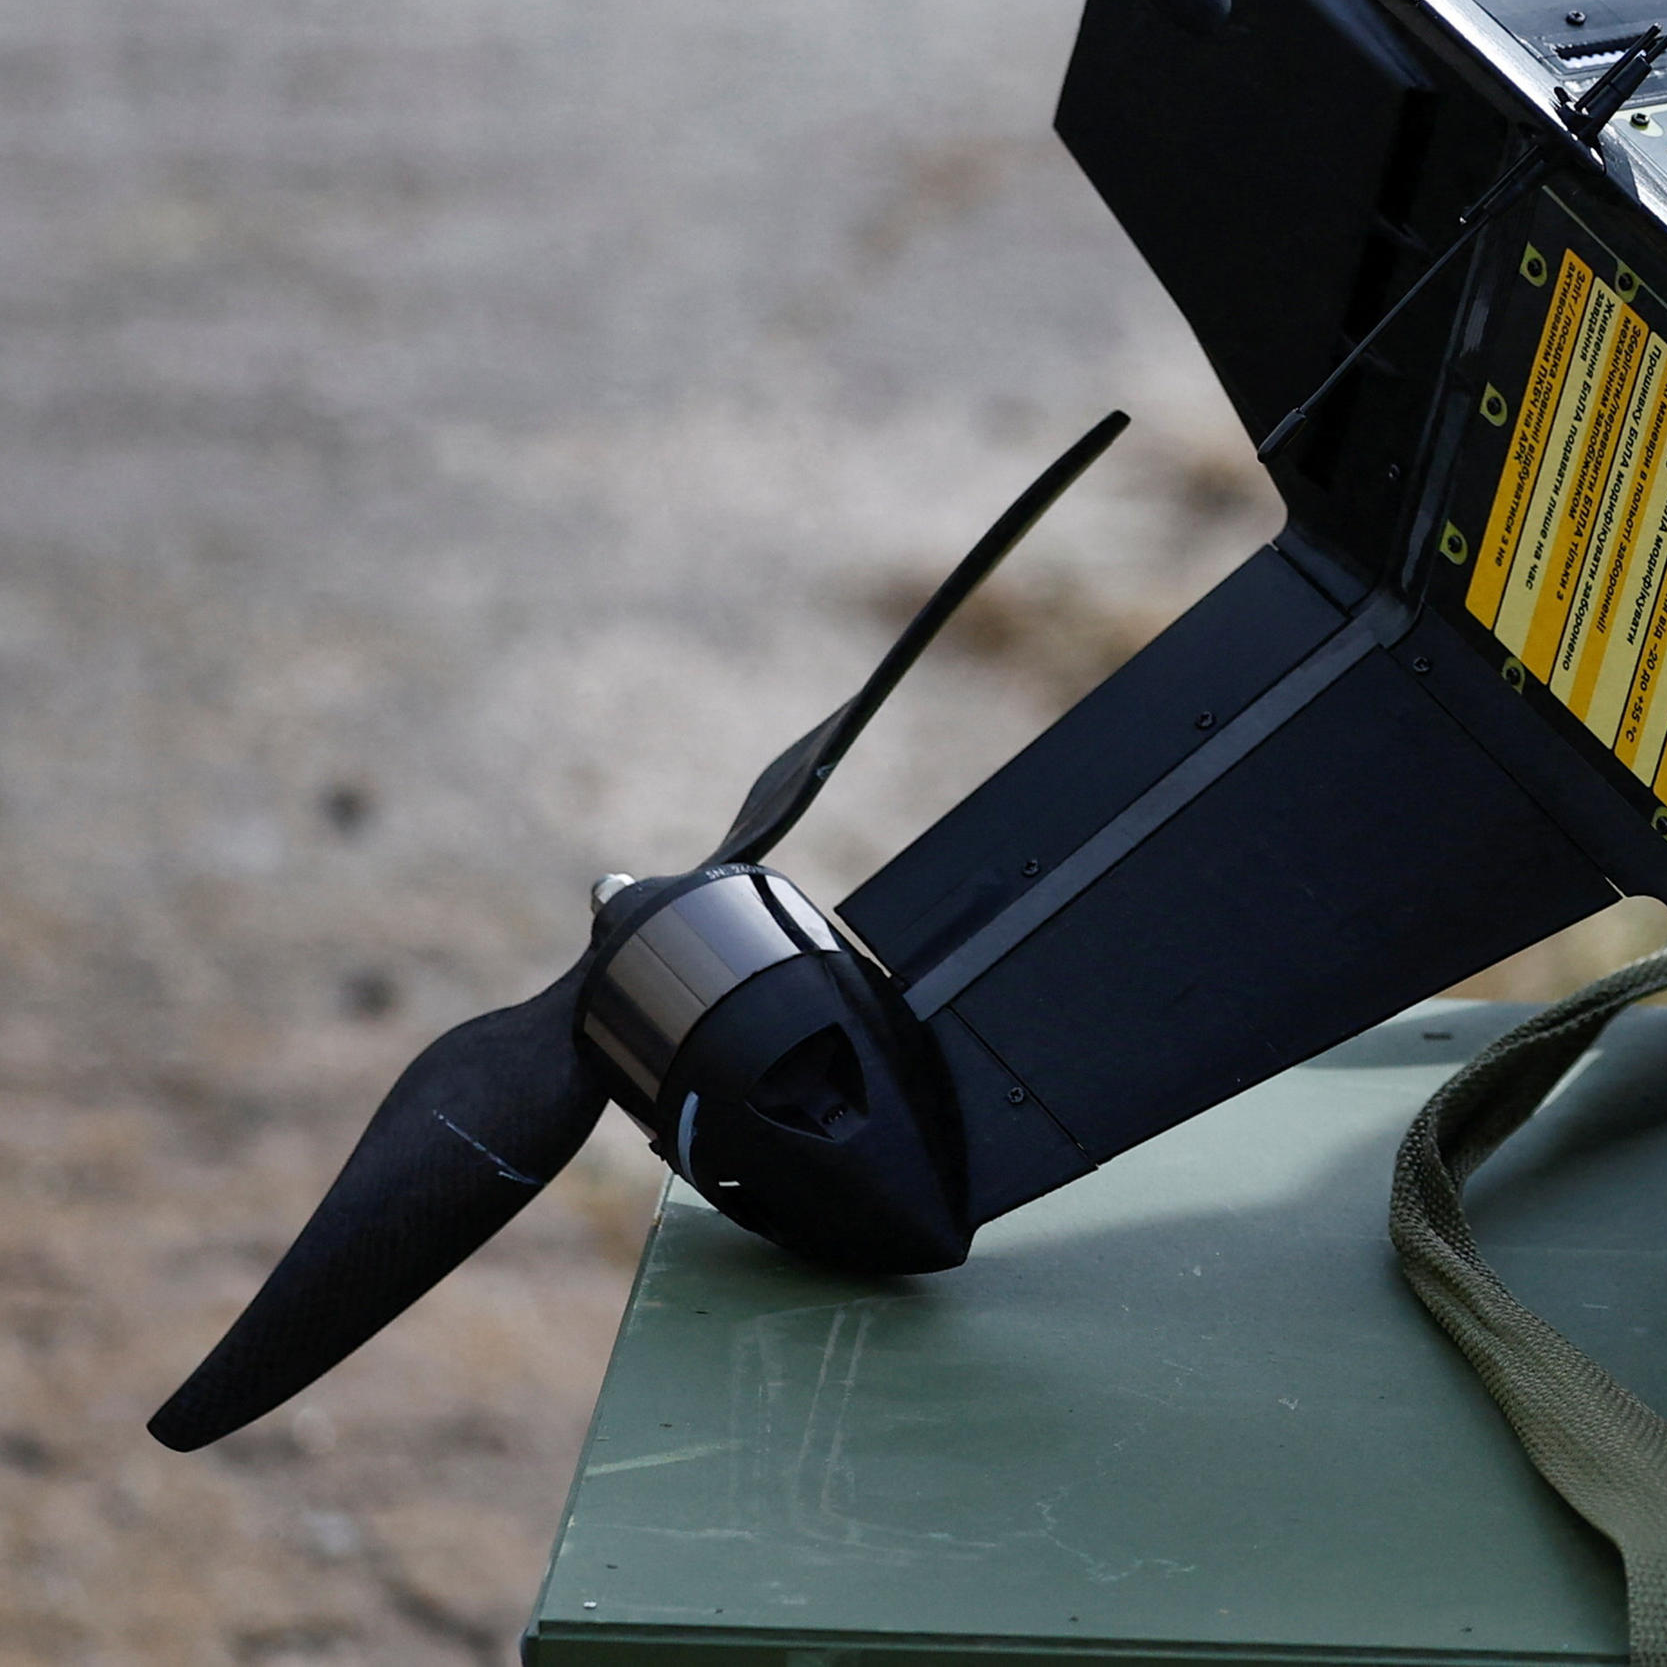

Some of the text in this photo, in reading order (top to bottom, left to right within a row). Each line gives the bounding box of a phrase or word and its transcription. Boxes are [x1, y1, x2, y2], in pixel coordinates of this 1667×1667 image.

[1542, 262, 1575, 362] активованим
[1571, 270, 1585, 304] Зліт
[1548, 315, 1571, 378] посадка
[1580, 289, 1604, 361] завдання
[1523, 409, 1534, 428] на
[1531, 381, 1552, 443] повинні
[1568, 316, 1631, 519] механічним запобіжником
[1587, 325, 1640, 491] Зберігати/перевозити
[1643, 401, 1667, 468] маневри
[1525, 298, 1614, 590] Живлення БпЛА подавати лише на час
[1639, 469, 1647, 481] в
[1504, 443, 1534, 533] відбуватися
[1562, 345, 1661, 670] Прошивку БпЛА модифікувати заборонено
[1622, 482, 1643, 542] польоті
[1494, 546, 1505, 566] не
[1500, 534, 1508, 545] з
[1559, 541, 1578, 589] тільки
[1556, 590, 1563, 600] з
[1596, 542, 1626, 632] заборонені!
[1627, 535, 1662, 644] модифікувати
[1653, 615, 1666, 639] від
[1631, 695, 1643, 722] +55
[1639, 668, 1650, 691] до
